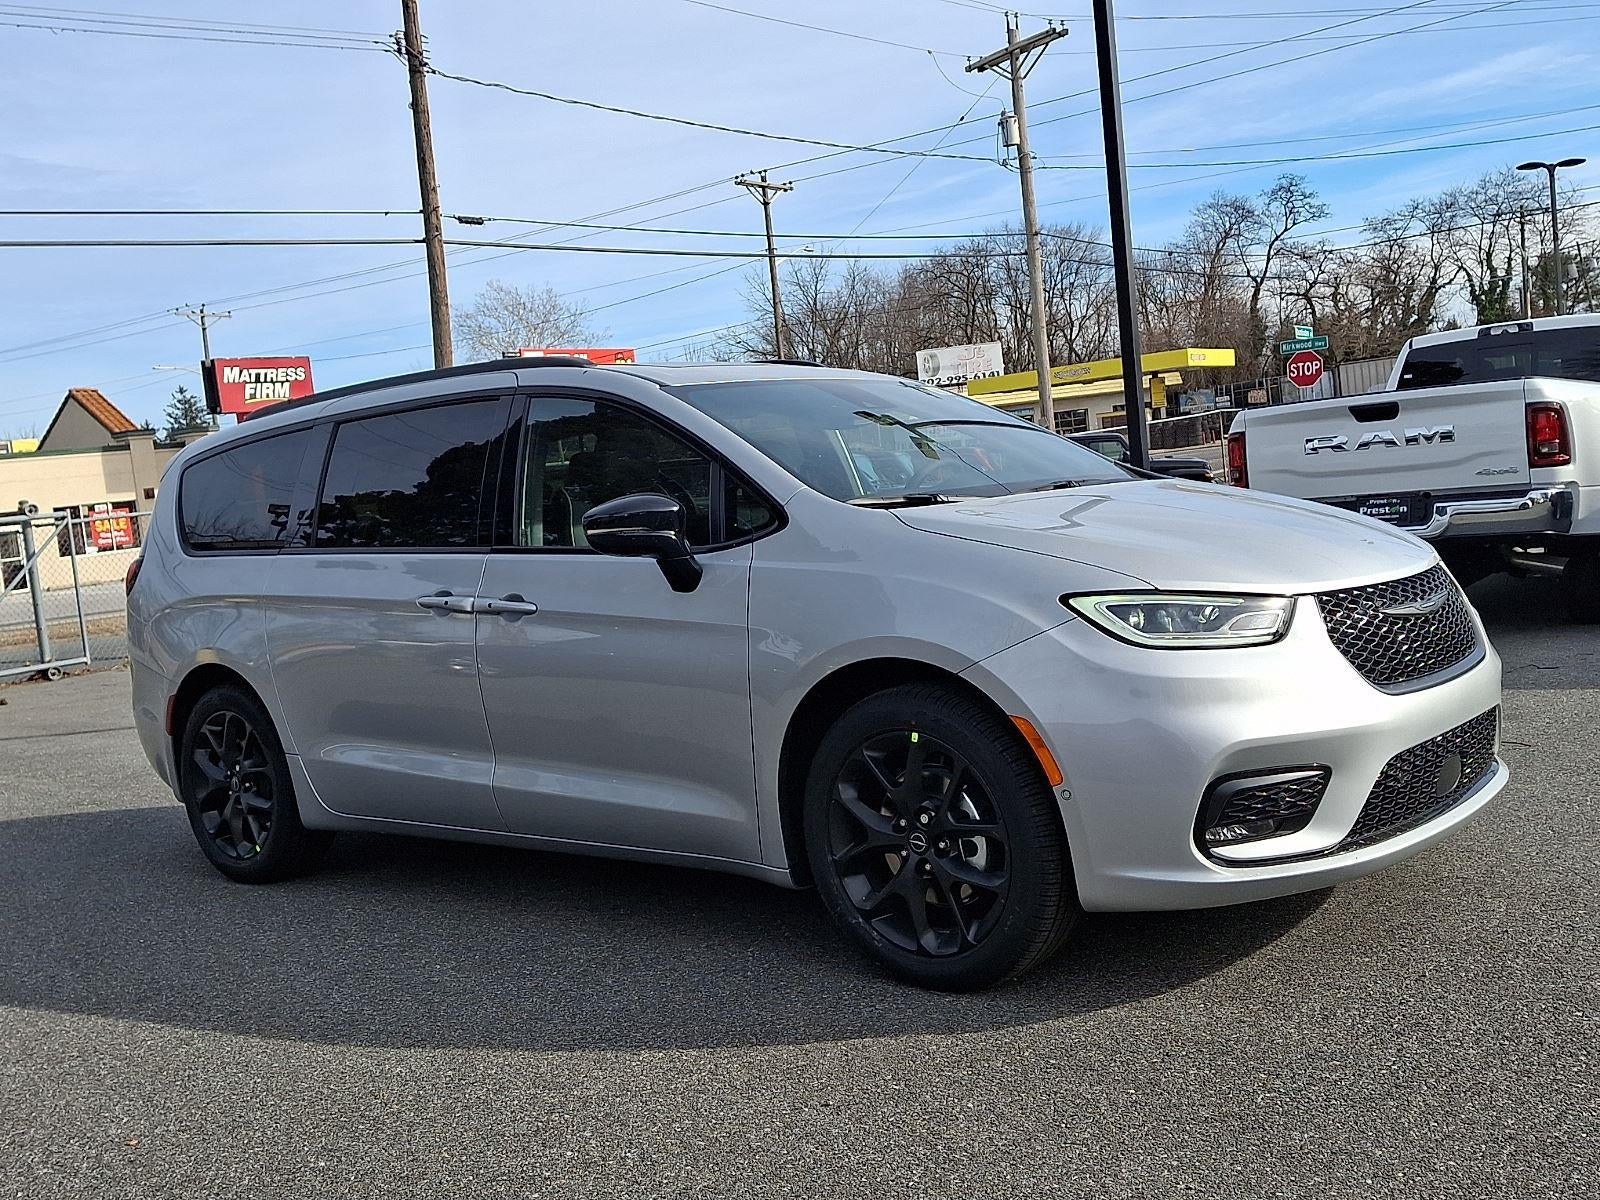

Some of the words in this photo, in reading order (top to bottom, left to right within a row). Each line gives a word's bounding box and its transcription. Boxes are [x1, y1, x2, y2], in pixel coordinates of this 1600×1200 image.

[1282, 340, 1312, 351] Kirkwood
[222, 366, 306, 384] MATTRESS
[1290, 361, 1320, 377] STOP
[244, 381, 290, 400] FIRM
[1304, 424, 1456, 456] RAM
[94, 518, 128, 533] SALE
